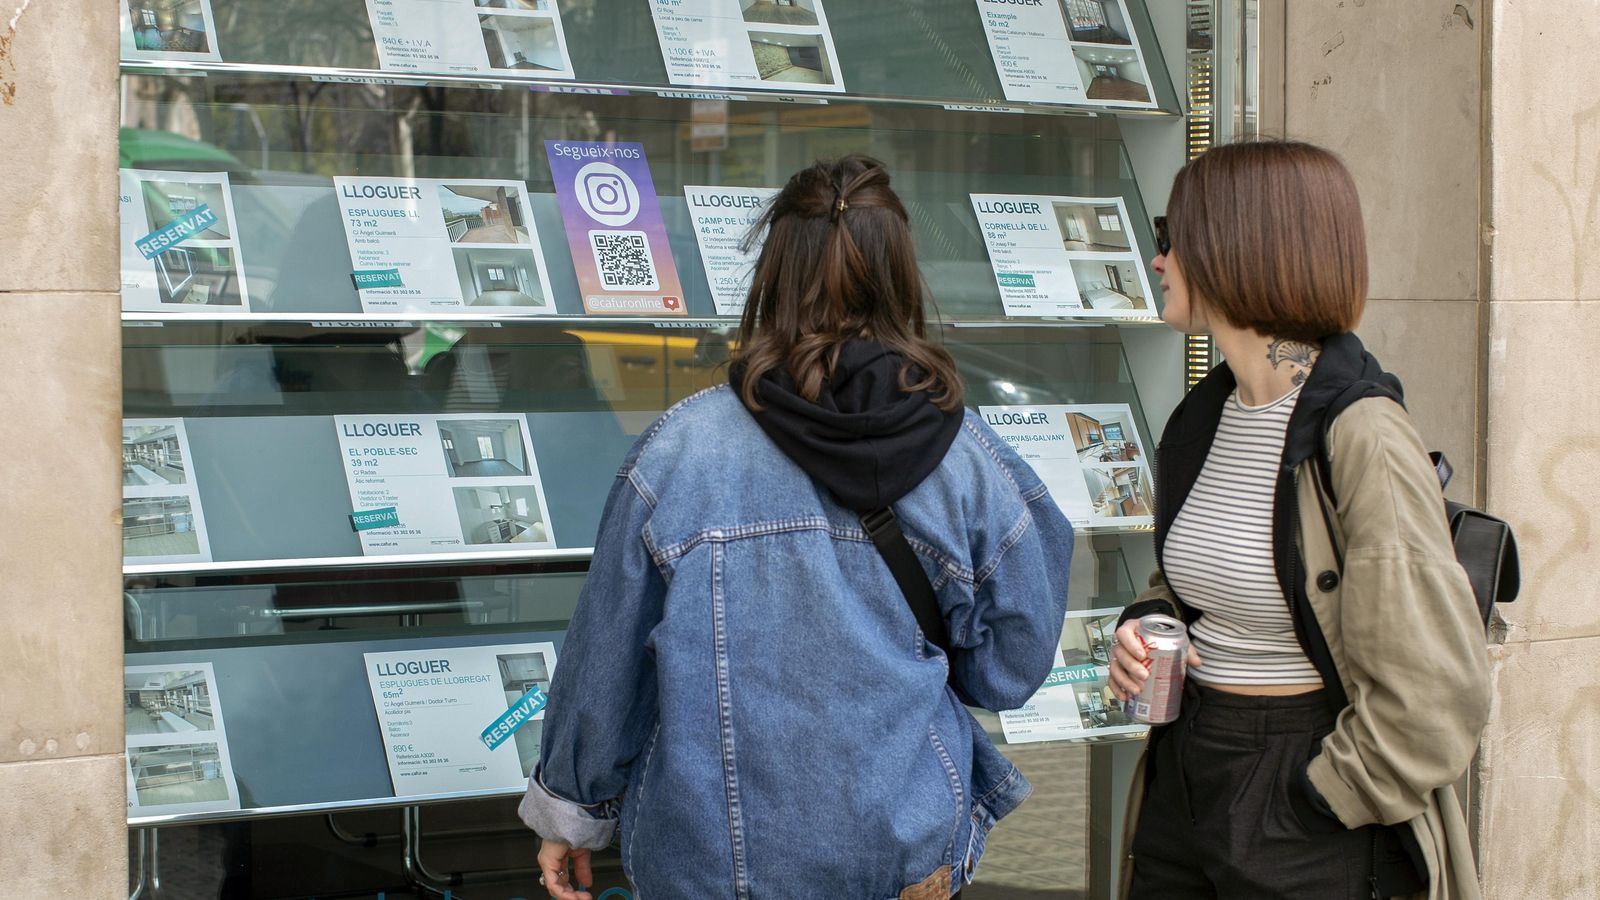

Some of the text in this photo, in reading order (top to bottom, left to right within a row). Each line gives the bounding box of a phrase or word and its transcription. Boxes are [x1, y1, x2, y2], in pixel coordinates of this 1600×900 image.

[987, 11, 1018, 20] Eixample
[989, 19, 998, 27] 50
[382, 37, 397, 45] 840
[398, 38, 404, 46] €
[668, 47, 687, 56] 1.100
[688, 48, 693, 56] €
[554, 143, 640, 160] Segueix-nos
[343, 185, 422, 200] LLOGUER
[692, 194, 762, 208] LLOGUER
[348, 208, 407, 218] ESPLUGUES
[977, 201, 1042, 215] LLOGUER
[350, 219, 378, 227] 73 m2
[698, 217, 723, 225] CAMP
[985, 221, 1027, 231] CORNELLÀ
[1027, 223, 1038, 231] DE
[139, 208, 214, 256] RESERVAT
[988, 231, 997, 239] 88
[355, 273, 400, 283] RESERVAT
[714, 277, 732, 285] 1.250
[998, 276, 1035, 286] RESERVAT
[588, 296, 661, 310] @cafuronline
[986, 412, 1050, 425] LLOGUER
[343, 424, 422, 437] LLOGUER
[349, 448, 418, 456] EL POBLE-SEC
[351, 459, 379, 467] 39 m2
[354, 512, 397, 524] RESERVAT
[376, 660, 452, 677] LLOGUER
[1046, 667, 1095, 683] ESERVAT
[379, 674, 491, 689] ESPLUGUES DE LLOBREGAT
[483, 689, 547, 748] RESERVAT
[393, 743, 414, 752] 890 €
